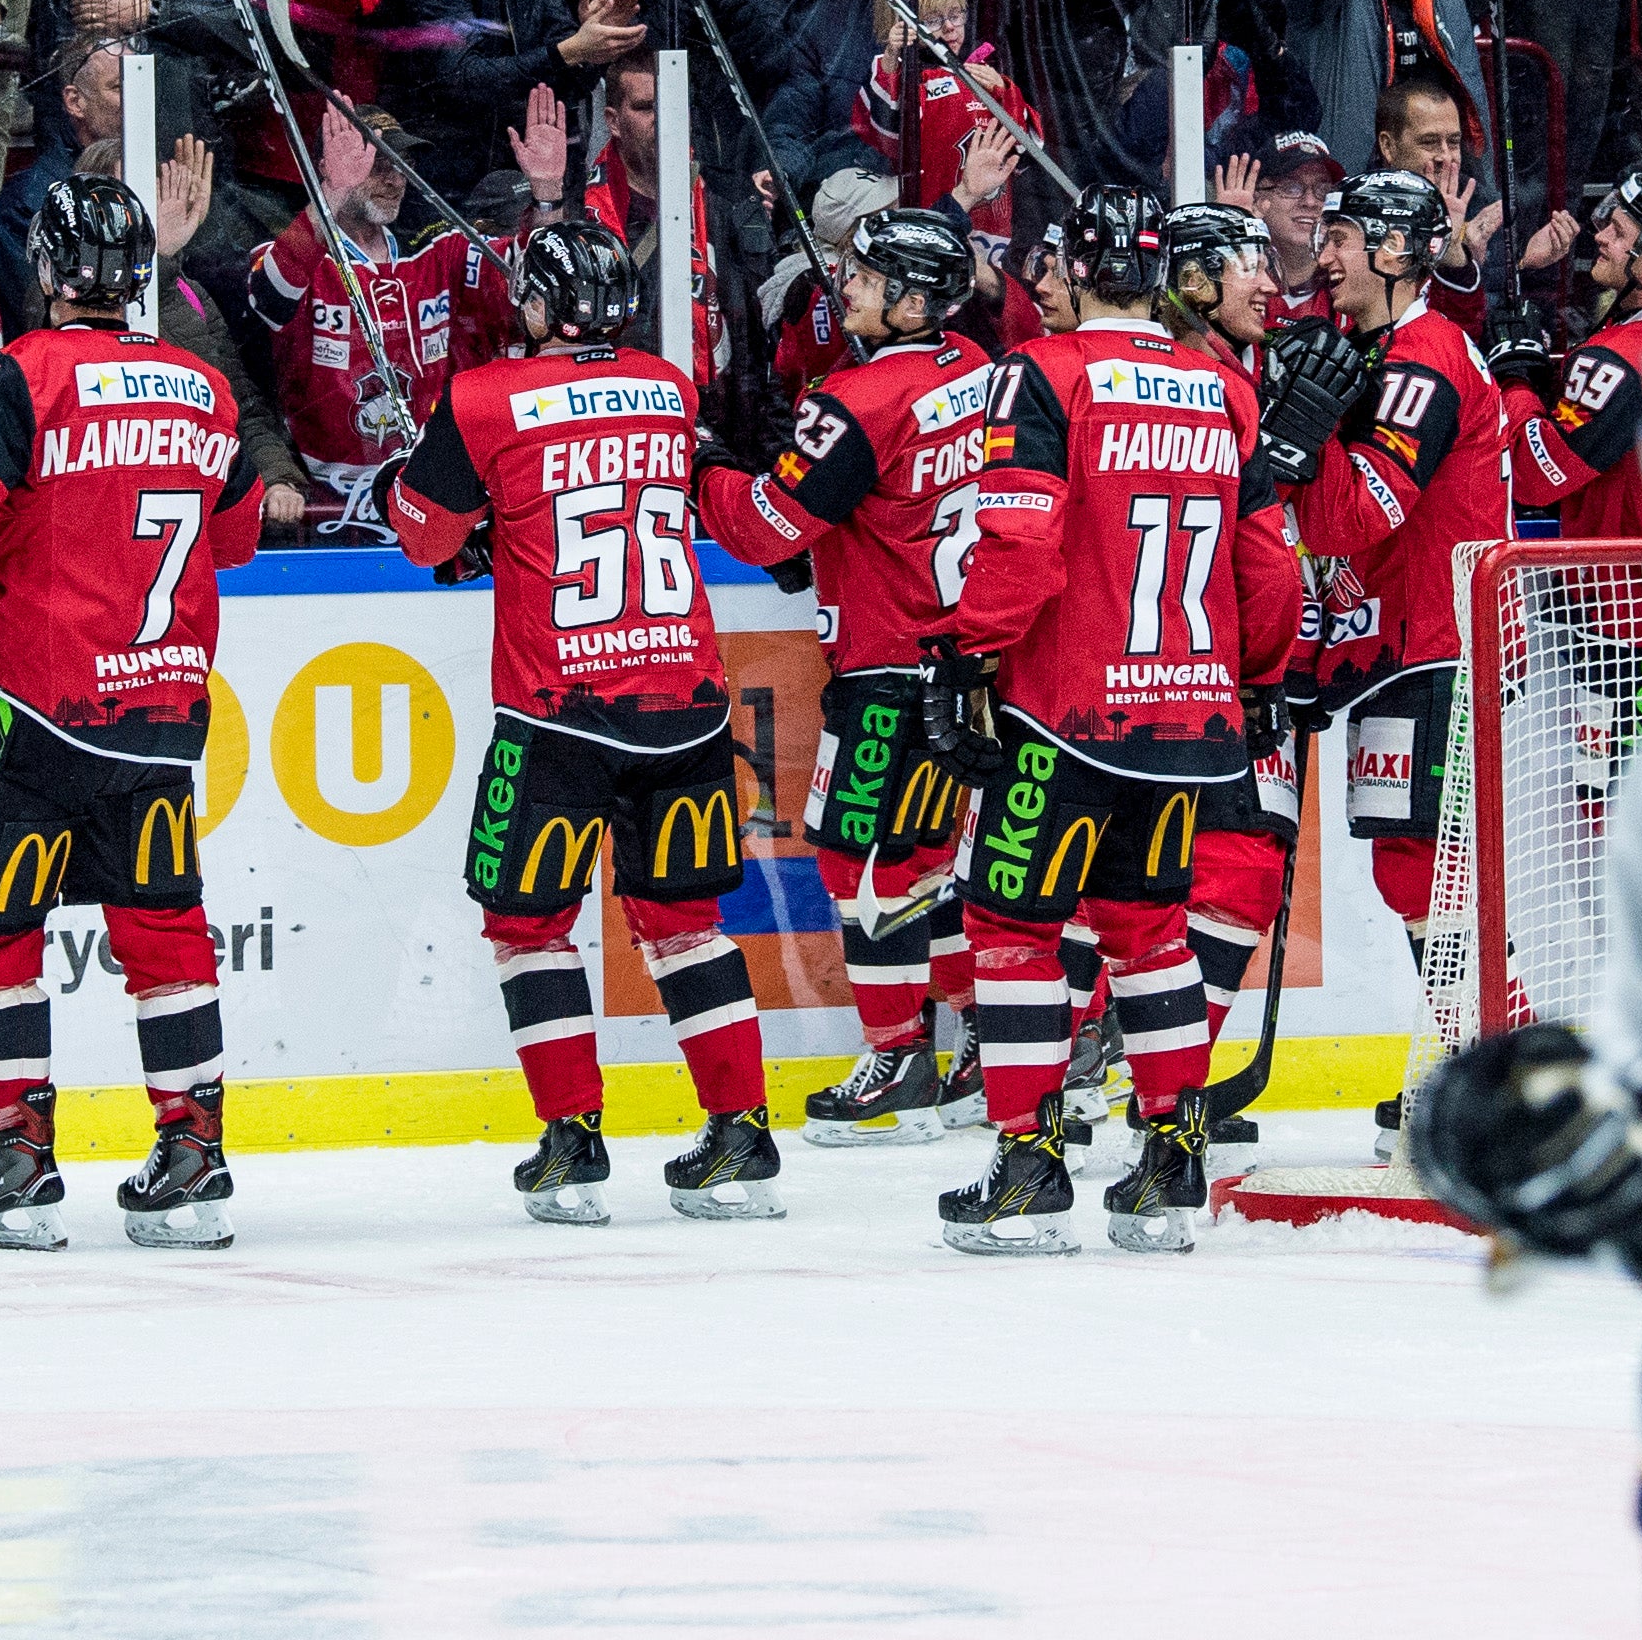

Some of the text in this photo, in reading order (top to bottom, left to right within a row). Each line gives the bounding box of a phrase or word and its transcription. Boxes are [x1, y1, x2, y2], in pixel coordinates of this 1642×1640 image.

[1382, 208, 1413, 217] CCM
[1173, 242, 1202, 254] CCM
[907, 272, 938, 283] CCM
[607, 305, 619, 316] 56
[119, 336, 155, 344] CCM
[1135, 340, 1171, 352] CCM
[936, 351, 962, 367] CCM
[123, 366, 211, 407] bravida
[567, 386, 681, 416] bravida
[1376, 372, 1436, 429] 10
[1565, 357, 1625, 410] 59
[795, 400, 847, 459] 23
[543, 432, 685, 492] EKBERG
[134, 492, 201, 644] 7
[554, 484, 694, 628] 56
[1127, 496, 1222, 654] 11
[98, 672, 155, 693] BESTÄLL
[158, 671, 182, 682] MAT
[561, 658, 617, 676] BESTÄLL
[621, 655, 647, 668] MAT
[1106, 691, 1159, 704] BESTÄLL
[1164, 691, 1189, 702] MAT
[837, 702, 902, 845] akea
[471, 737, 524, 890] akea
[986, 742, 1058, 900] akea
